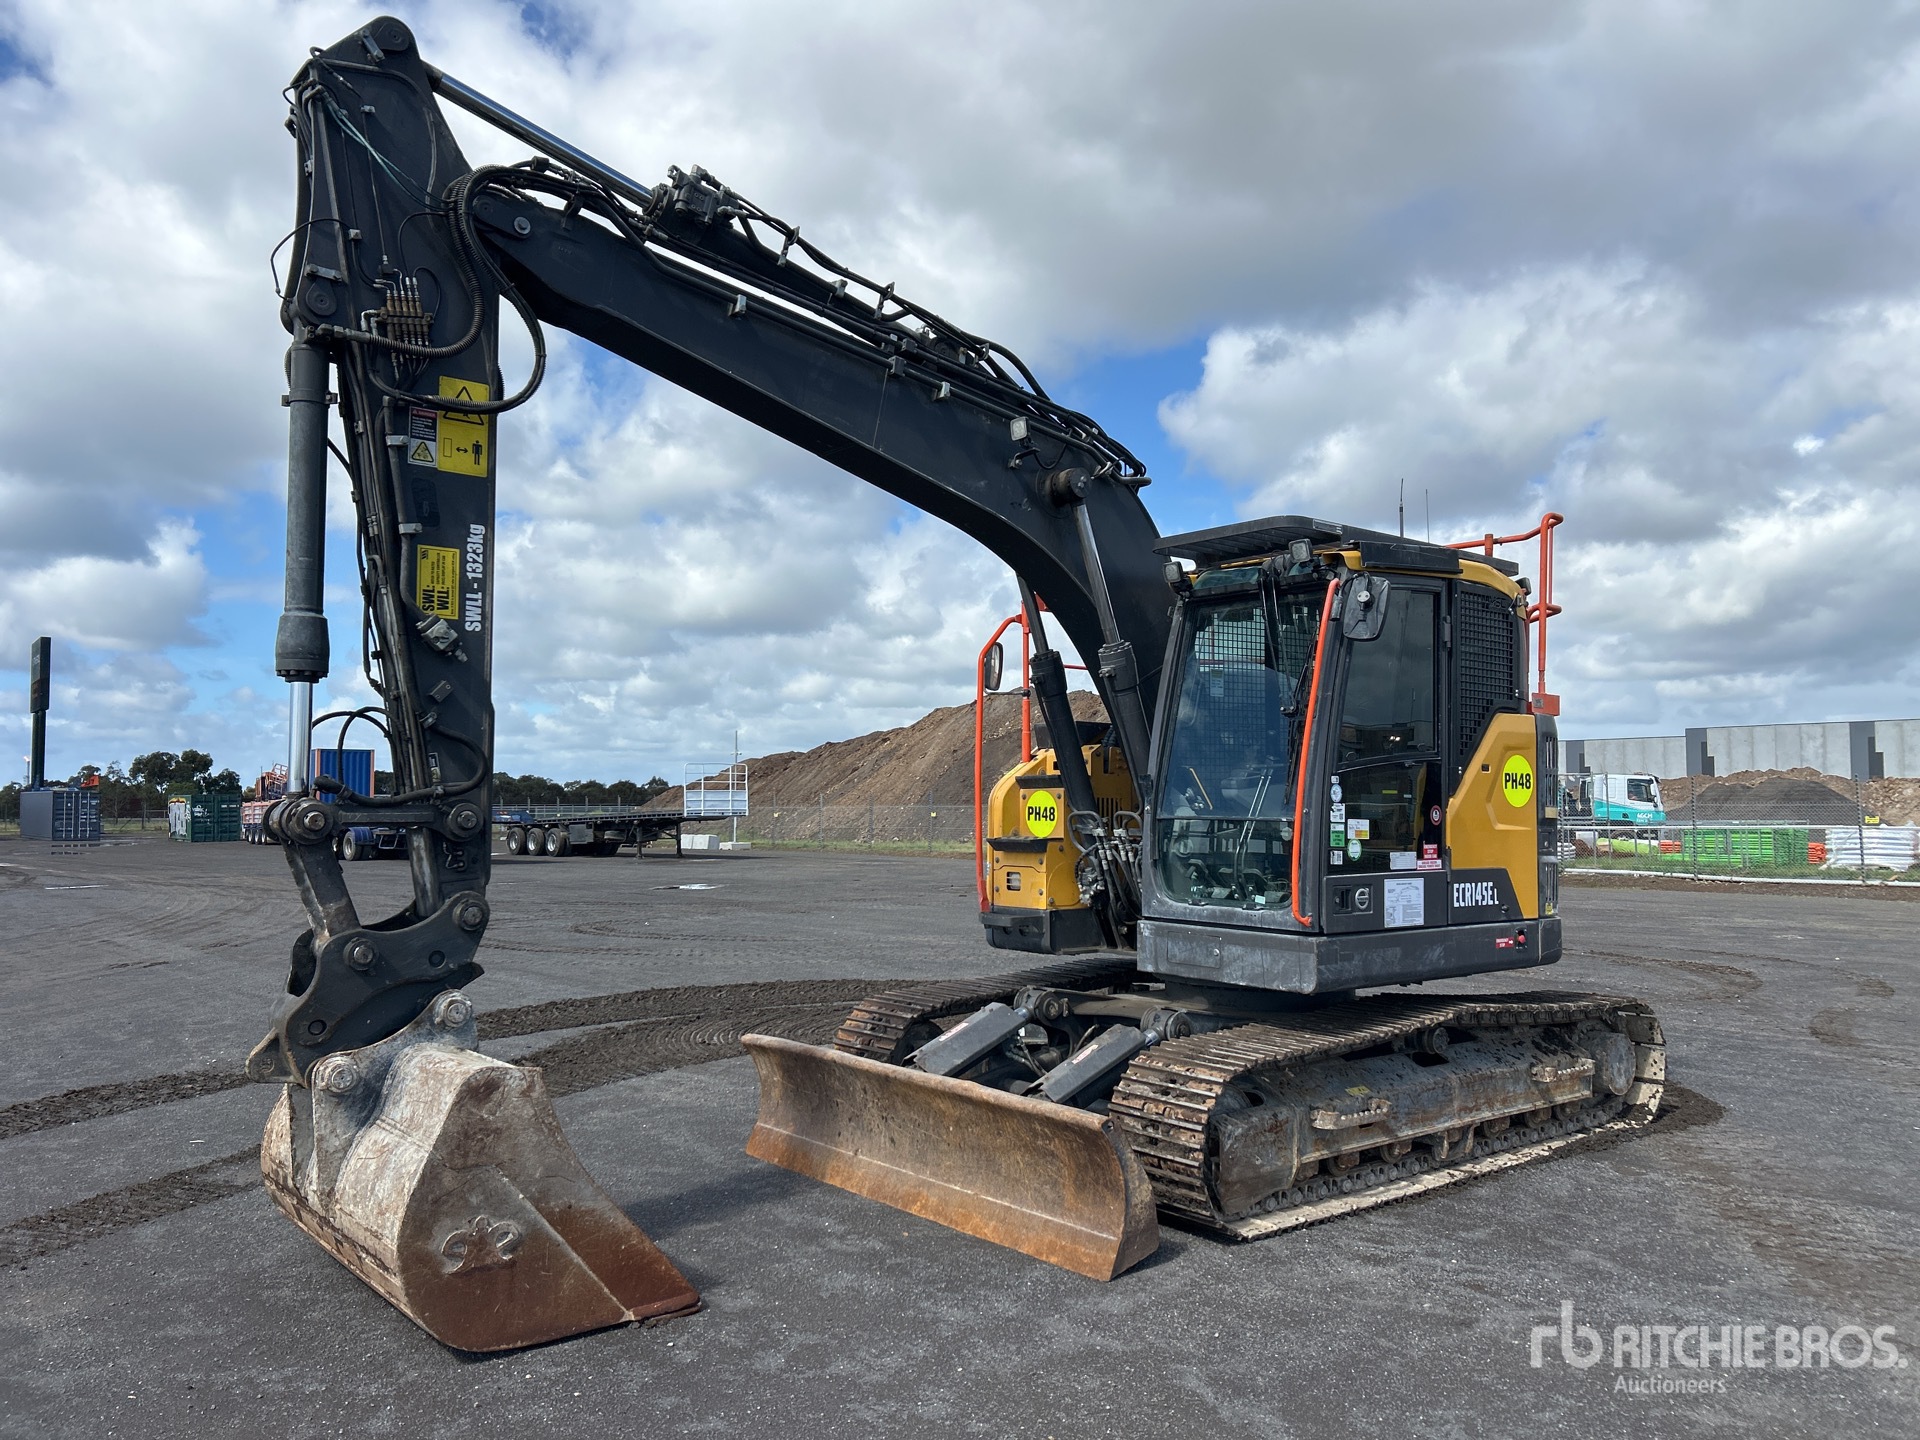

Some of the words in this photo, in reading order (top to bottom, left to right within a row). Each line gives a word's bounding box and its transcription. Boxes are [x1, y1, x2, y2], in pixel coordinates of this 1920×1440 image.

[466, 523, 486, 579] 1323kg
[421, 584, 435, 612] SWL:
[436, 586, 449, 611] WLL:
[465, 592, 482, 632] SWLL
[1504, 772, 1532, 790] PH48
[1027, 806, 1056, 822] PH48
